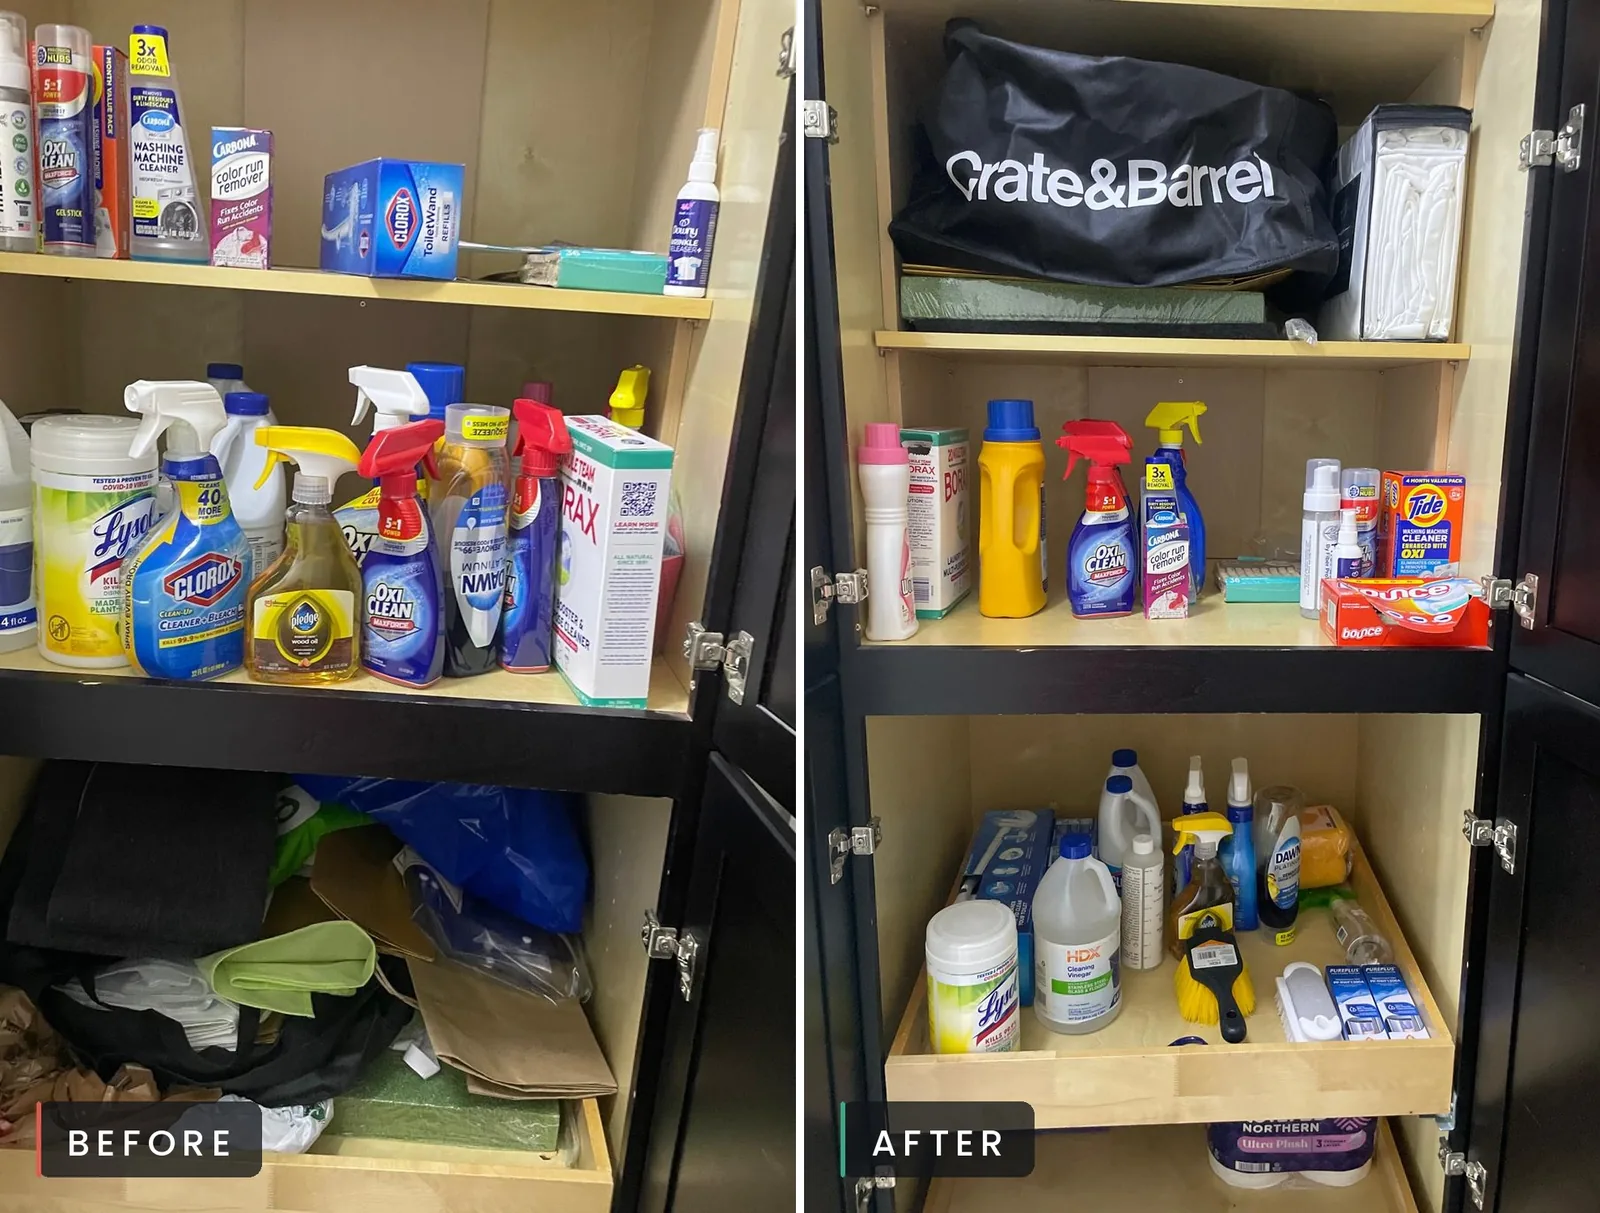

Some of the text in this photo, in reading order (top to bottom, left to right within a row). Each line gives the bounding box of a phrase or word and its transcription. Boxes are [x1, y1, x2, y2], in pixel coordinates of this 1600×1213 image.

[47, 54, 71, 64] NUBS
[105, 57, 113, 86] MONTH
[131, 64, 164, 73] REMOVAL
[148, 96, 174, 104] RESIDUES
[44, 139, 67, 157] OXI
[133, 142, 183, 154] WASHING
[213, 134, 257, 158] CARBONA
[133, 153, 184, 165] MACHINE
[139, 164, 179, 173] CLEANER
[216, 159, 264, 185] color run
[219, 171, 264, 195] remover
[946, 150, 1275, 210] Crate&Barrel
[56, 209, 83, 218] GEL STICK
[217, 217, 230, 226] Run
[231, 204, 264, 222] Accidents
[220, 199, 258, 217] Fixes Color
[394, 196, 410, 243] CLOROX
[424, 187, 438, 257] ToiletWand
[441, 204, 451, 242] REFILLS
[579, 457, 596, 482] TEAM
[909, 465, 936, 476] ORAX
[121, 475, 141, 483] PROVEN
[133, 481, 149, 489] VIRUS
[944, 468, 969, 502] BORA
[198, 506, 222, 515] MORE
[563, 484, 600, 546] RAX
[1408, 494, 1445, 521] Tide
[93, 501, 154, 558] Lysol
[383, 528, 401, 537] POWER
[1148, 529, 1181, 547] CARBONA
[1095, 545, 1119, 560] OXI
[1150, 544, 1185, 564] color run
[1152, 552, 1185, 571] remover
[1401, 549, 1426, 559] OXI
[1085, 553, 1125, 573] CLEAN
[103, 577, 119, 585] KIL
[174, 559, 236, 601] CLOROX
[461, 568, 505, 594] DAWN
[1153, 571, 1182, 586] Fixes Color
[1161, 575, 1185, 588] Accidents
[375, 582, 404, 603] OXI
[1359, 584, 1450, 601] ounce
[124, 593, 132, 619] EVERY
[159, 608, 193, 618] CLEAN-UP
[367, 594, 414, 619] CLEAN
[17, 616, 27, 624] oz
[159, 616, 201, 631] CLEANER
[207, 607, 238, 622] BLEACH
[291, 612, 319, 629] pledge
[373, 618, 409, 630] MAXFORCE
[564, 620, 591, 651] CLEANER
[1341, 626, 1383, 640] bounce
[1066, 945, 1102, 963] HDX
[1067, 964, 1095, 972] Cleaning
[978, 968, 1018, 1027] Lysol
[984, 1032, 1002, 1045] KILLS
[1242, 1122, 1320, 1133] NORTHERN
[1242, 1139, 1308, 1149] Ultra Plush
[1315, 1139, 1322, 1148] 3
